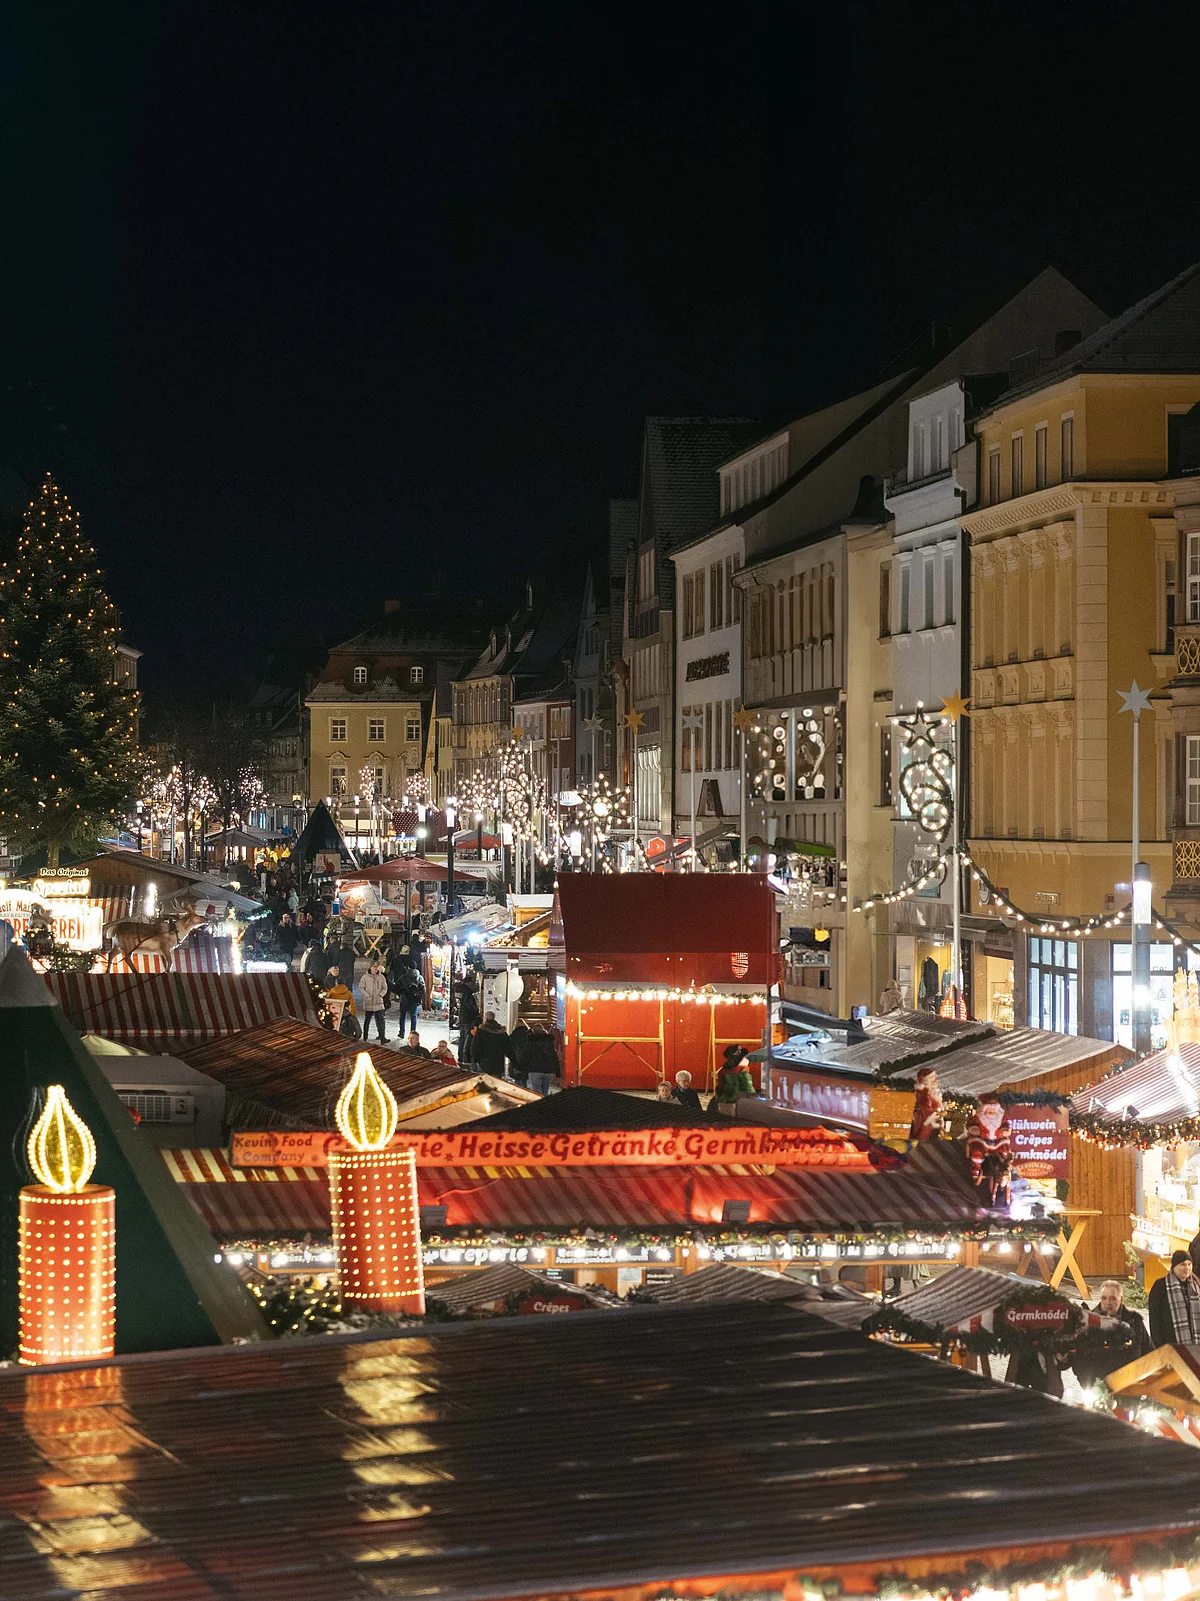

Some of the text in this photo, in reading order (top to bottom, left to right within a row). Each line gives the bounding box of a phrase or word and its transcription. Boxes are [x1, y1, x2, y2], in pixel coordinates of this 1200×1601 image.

[40, 867, 90, 878] Das Original
[282, 1134, 313, 1147] Food
[459, 1134, 545, 1159] Heisse
[550, 1133, 677, 1161] Getränke
[1015, 1134, 1054, 1148] Crêpes
[243, 1151, 305, 1163] Company
[1011, 1149, 1067, 1161] rmknödel
[533, 1301, 570, 1315] Crêpes
[1007, 1308, 1069, 1322] Germknödel
